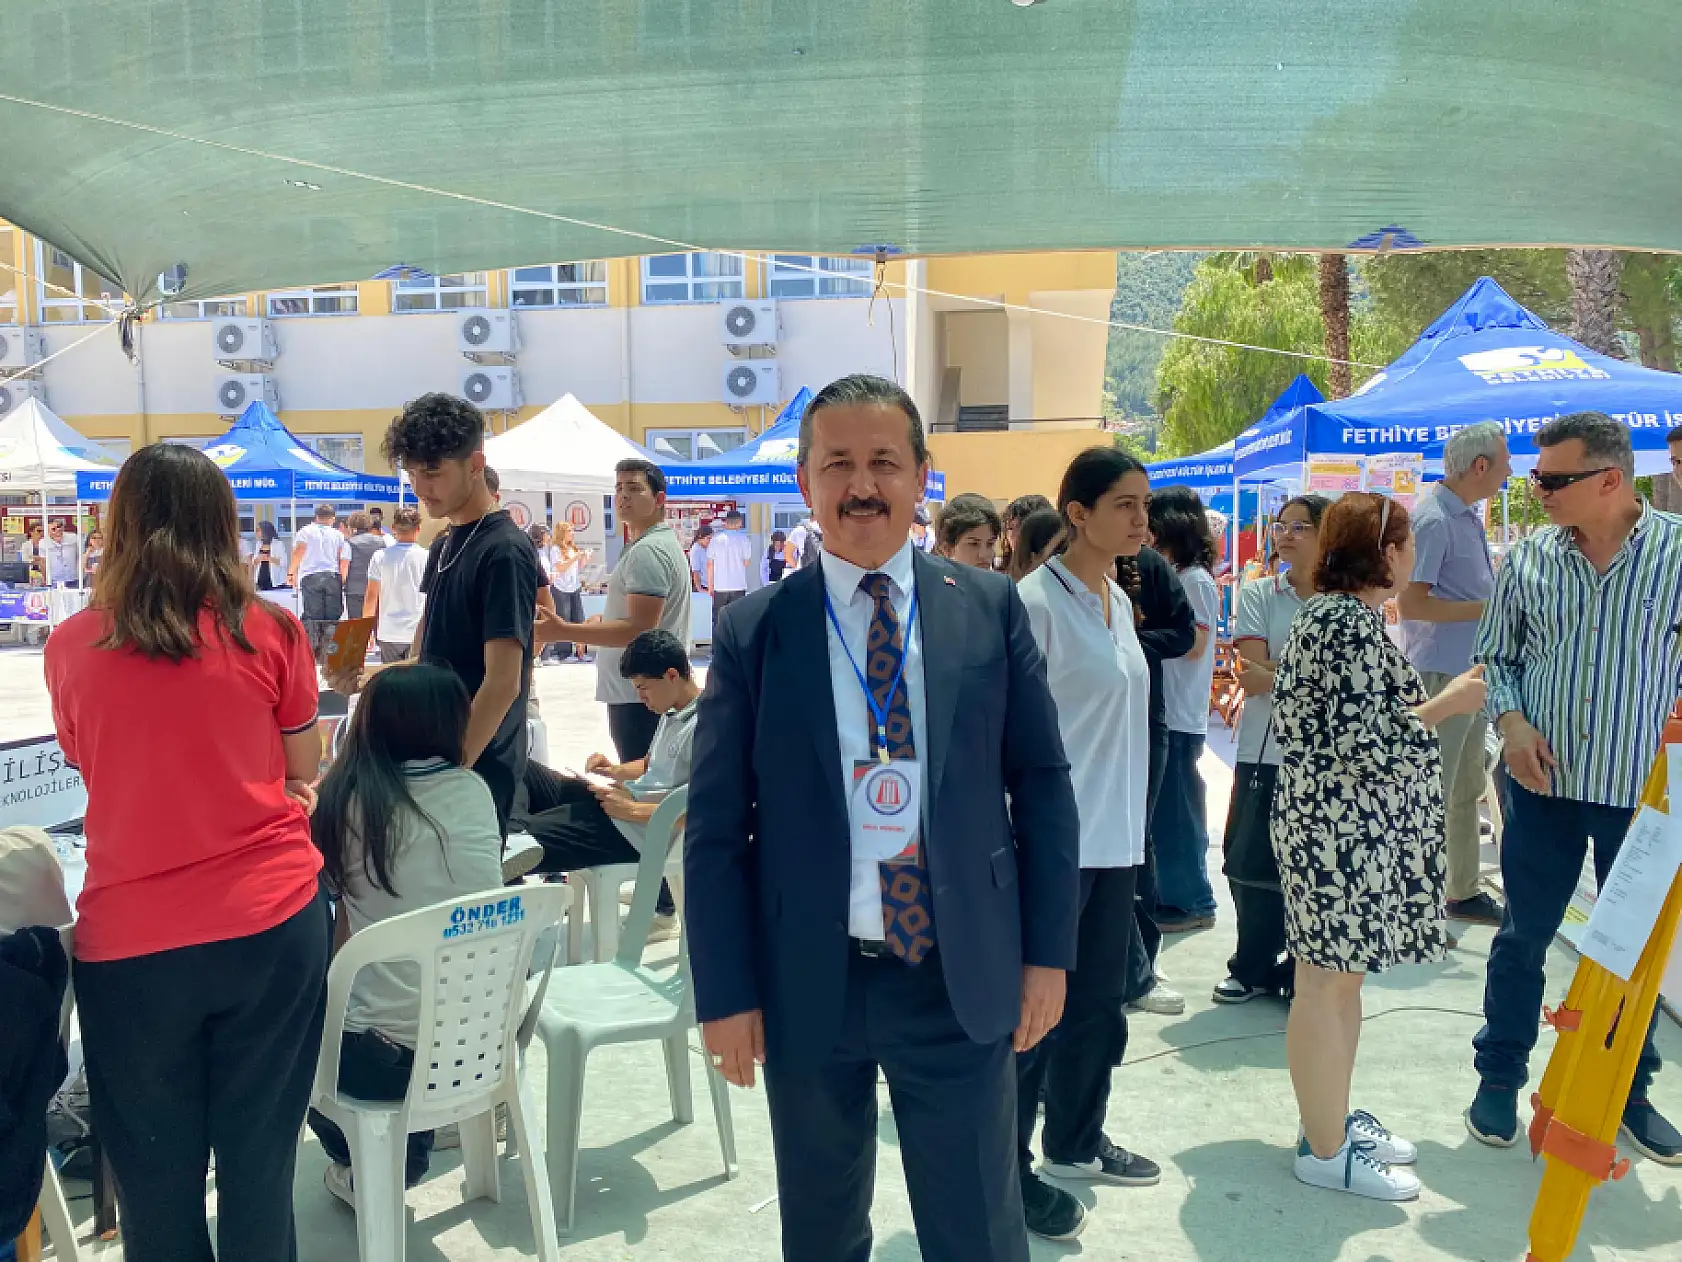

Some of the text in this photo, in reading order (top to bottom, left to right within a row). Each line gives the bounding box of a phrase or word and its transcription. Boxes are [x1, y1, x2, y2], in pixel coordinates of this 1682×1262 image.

[1343, 424, 1430, 445] FETHİYE
[1611, 409, 1661, 428] TÜR
[89, 480, 114, 491] FETH
[231, 476, 252, 489] LERİ
[664, 472, 798, 485] FETHİYE BELEDİYESİ KÜLT
[3, 750, 62, 785] İLİŞ
[450, 895, 522, 924] ÖNDER
